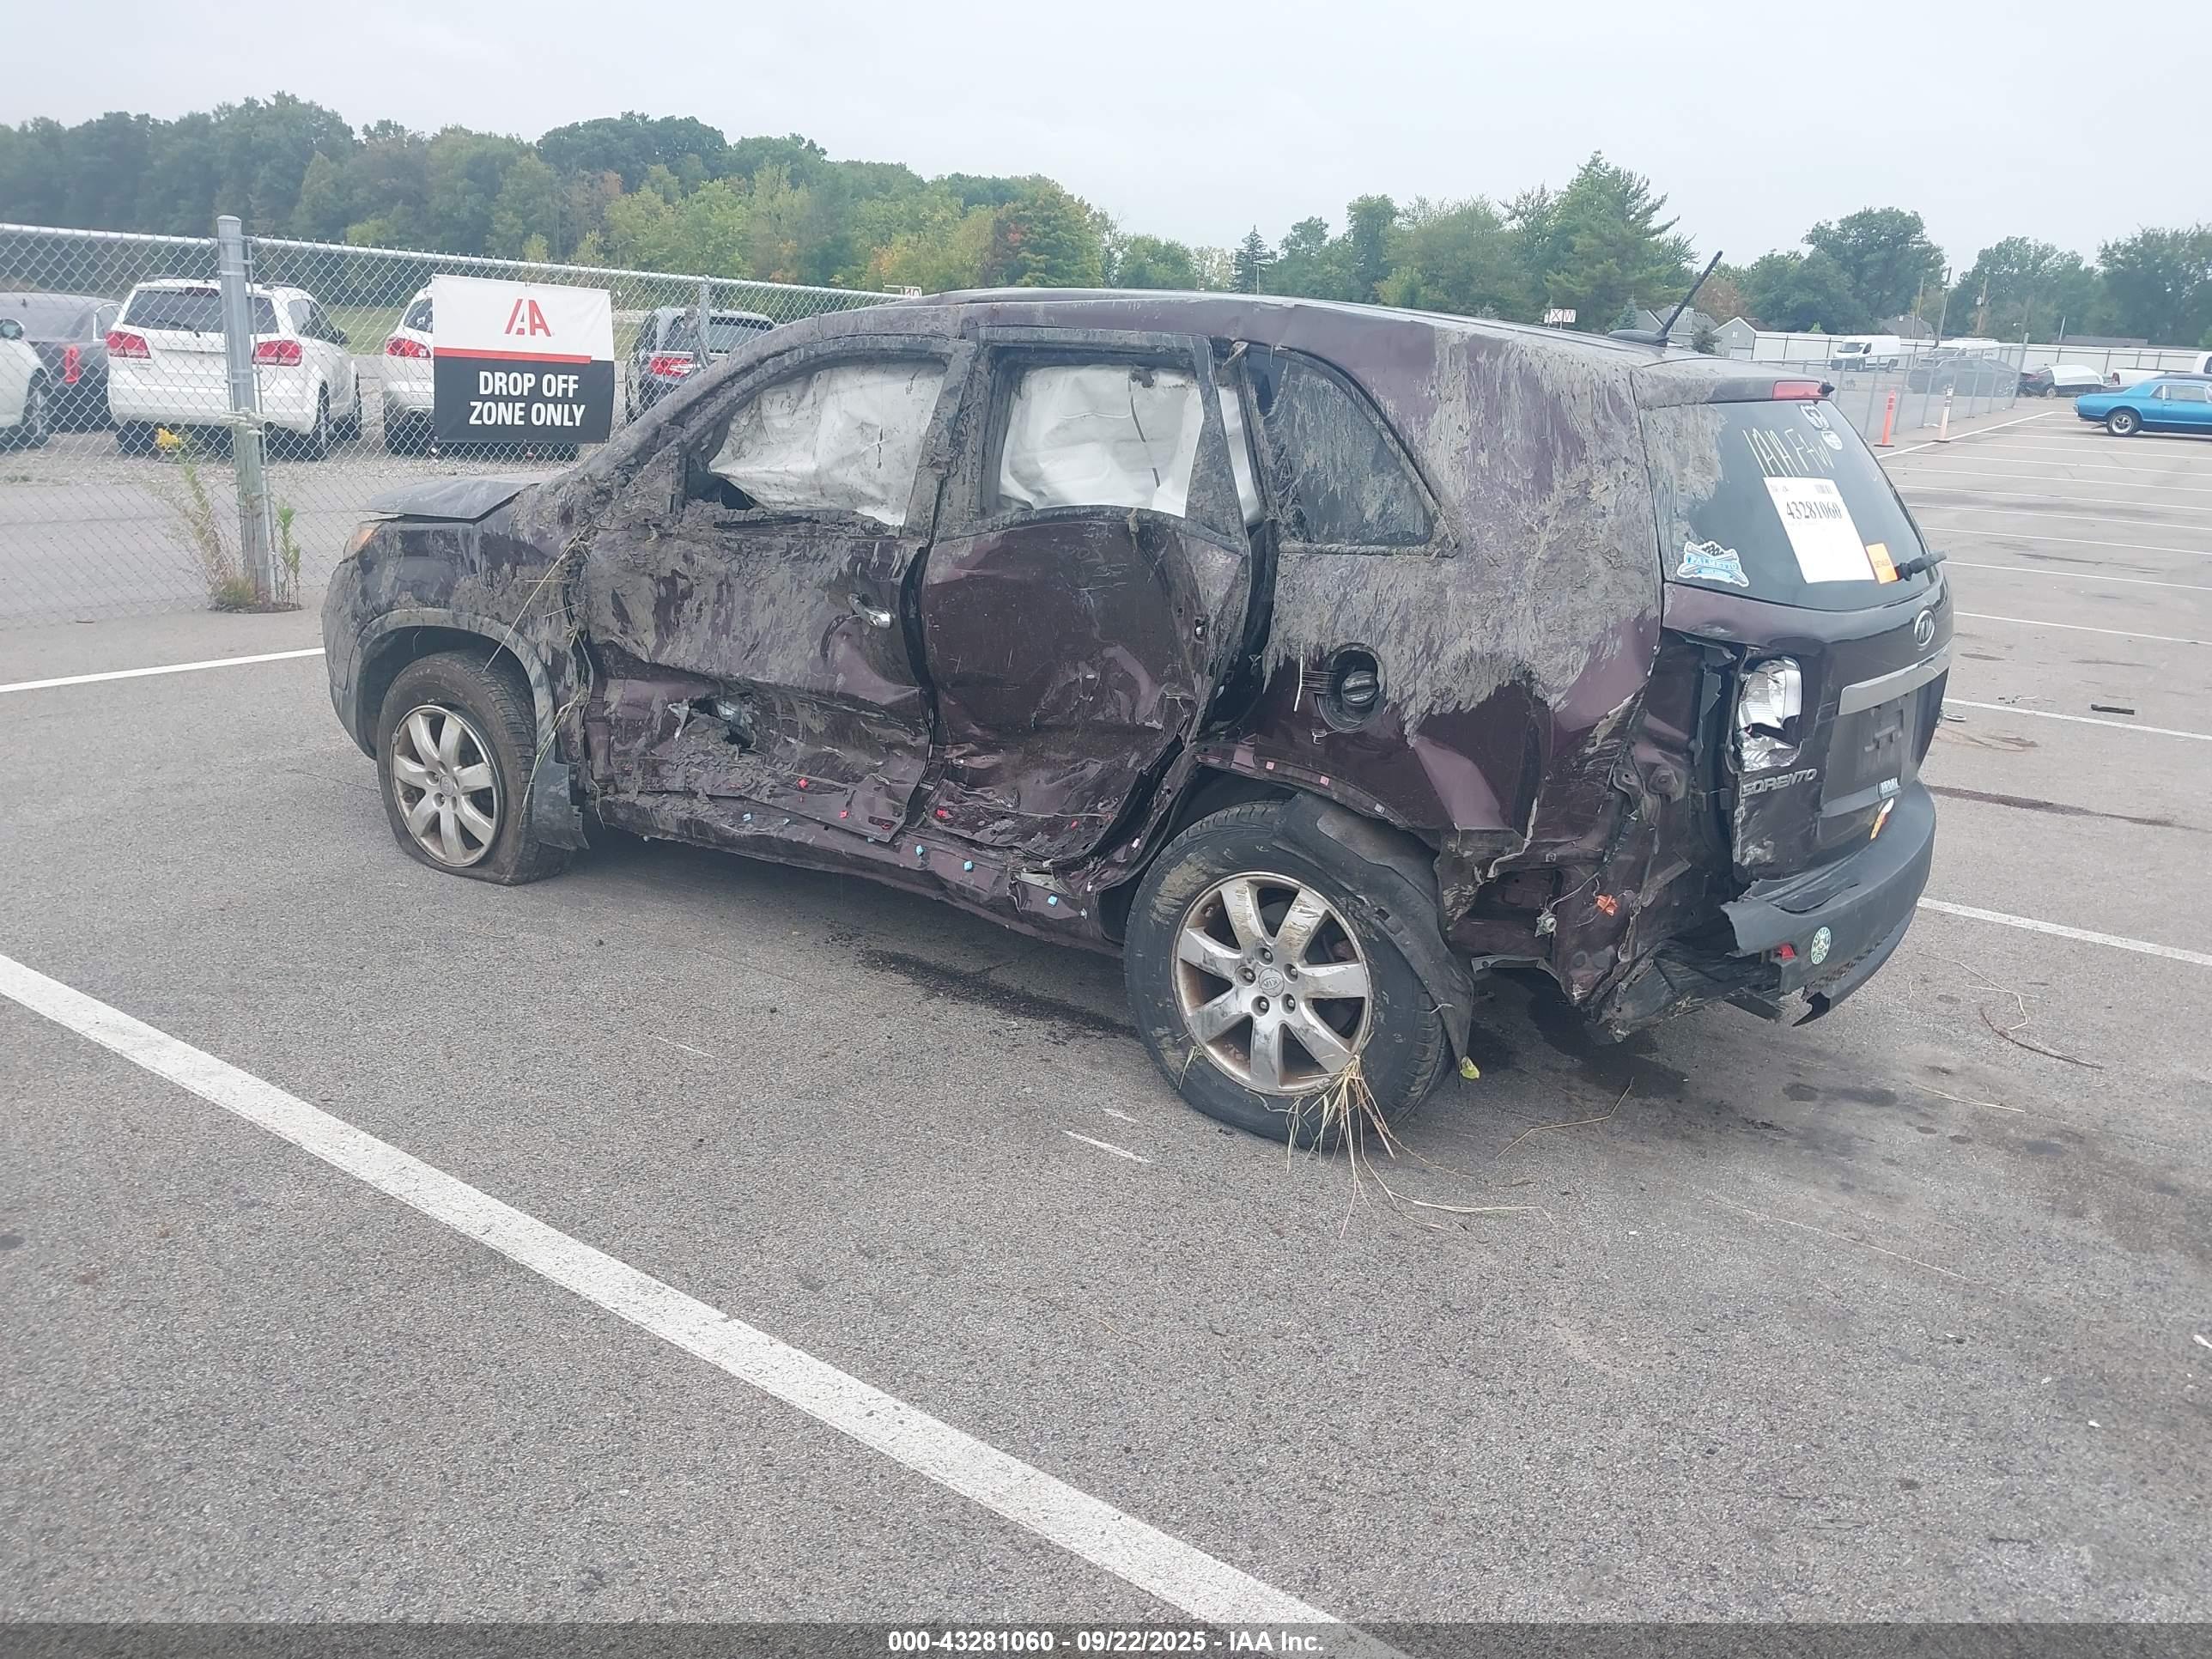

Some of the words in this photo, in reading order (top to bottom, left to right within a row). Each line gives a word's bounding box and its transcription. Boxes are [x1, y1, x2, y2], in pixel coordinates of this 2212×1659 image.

[478, 371, 536, 397] DROP
[542, 374, 579, 398] OFF
[469, 401, 526, 425] ZONE
[531, 402, 586, 427] ONLY
[1786, 501, 1843, 520] 43281060
[1740, 769, 1818, 798] SORENTO
